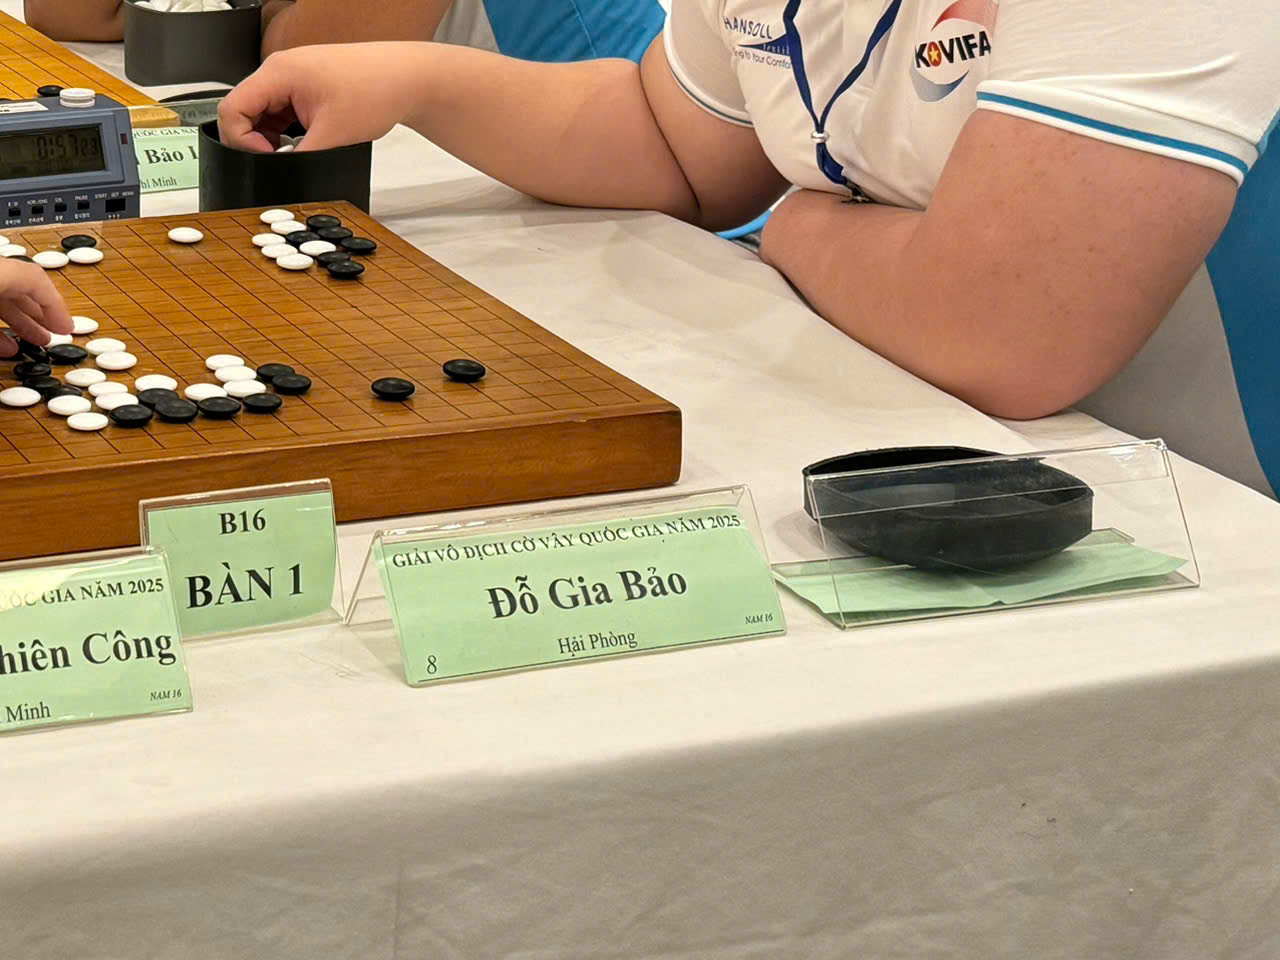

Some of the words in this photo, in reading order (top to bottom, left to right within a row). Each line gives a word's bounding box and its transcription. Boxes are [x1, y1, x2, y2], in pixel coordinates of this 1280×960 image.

[724, 16, 772, 40] HANSOLL
[915, 30, 992, 69] KOVIFA
[144, 147, 184, 164] Bảo
[152, 177, 178, 188] Minh
[218, 508, 266, 536] B16
[392, 550, 432, 568] GIẢI
[434, 544, 460, 562] VÔ
[462, 542, 508, 560] ĐỊCH
[510, 536, 537, 554] CỜ
[538, 532, 574, 550] VÂY
[578, 525, 630, 546] QUỐC
[631, 524, 664, 538] GIA
[664, 516, 706, 534] NĂM
[708, 514, 741, 529] 2025
[42, 588, 76, 604] GIA
[80, 580, 124, 600] NĂM
[128, 578, 164, 594] 2025
[185, 562, 275, 610] BÀN
[288, 563, 304, 596] 1
[484, 575, 539, 619] Đỗ
[548, 575, 614, 610] Gia
[616, 566, 688, 602] Bảo
[744, 614, 764, 626] NAM
[764, 612, 774, 623] 16
[82, 630, 177, 666] Công
[558, 636, 586, 657] Hải
[590, 631, 638, 651] Phòng
[426, 655, 438, 675] 8
[150, 690, 170, 702] NAM
[172, 688, 182, 699] 16
[6, 701, 52, 722] Minh
